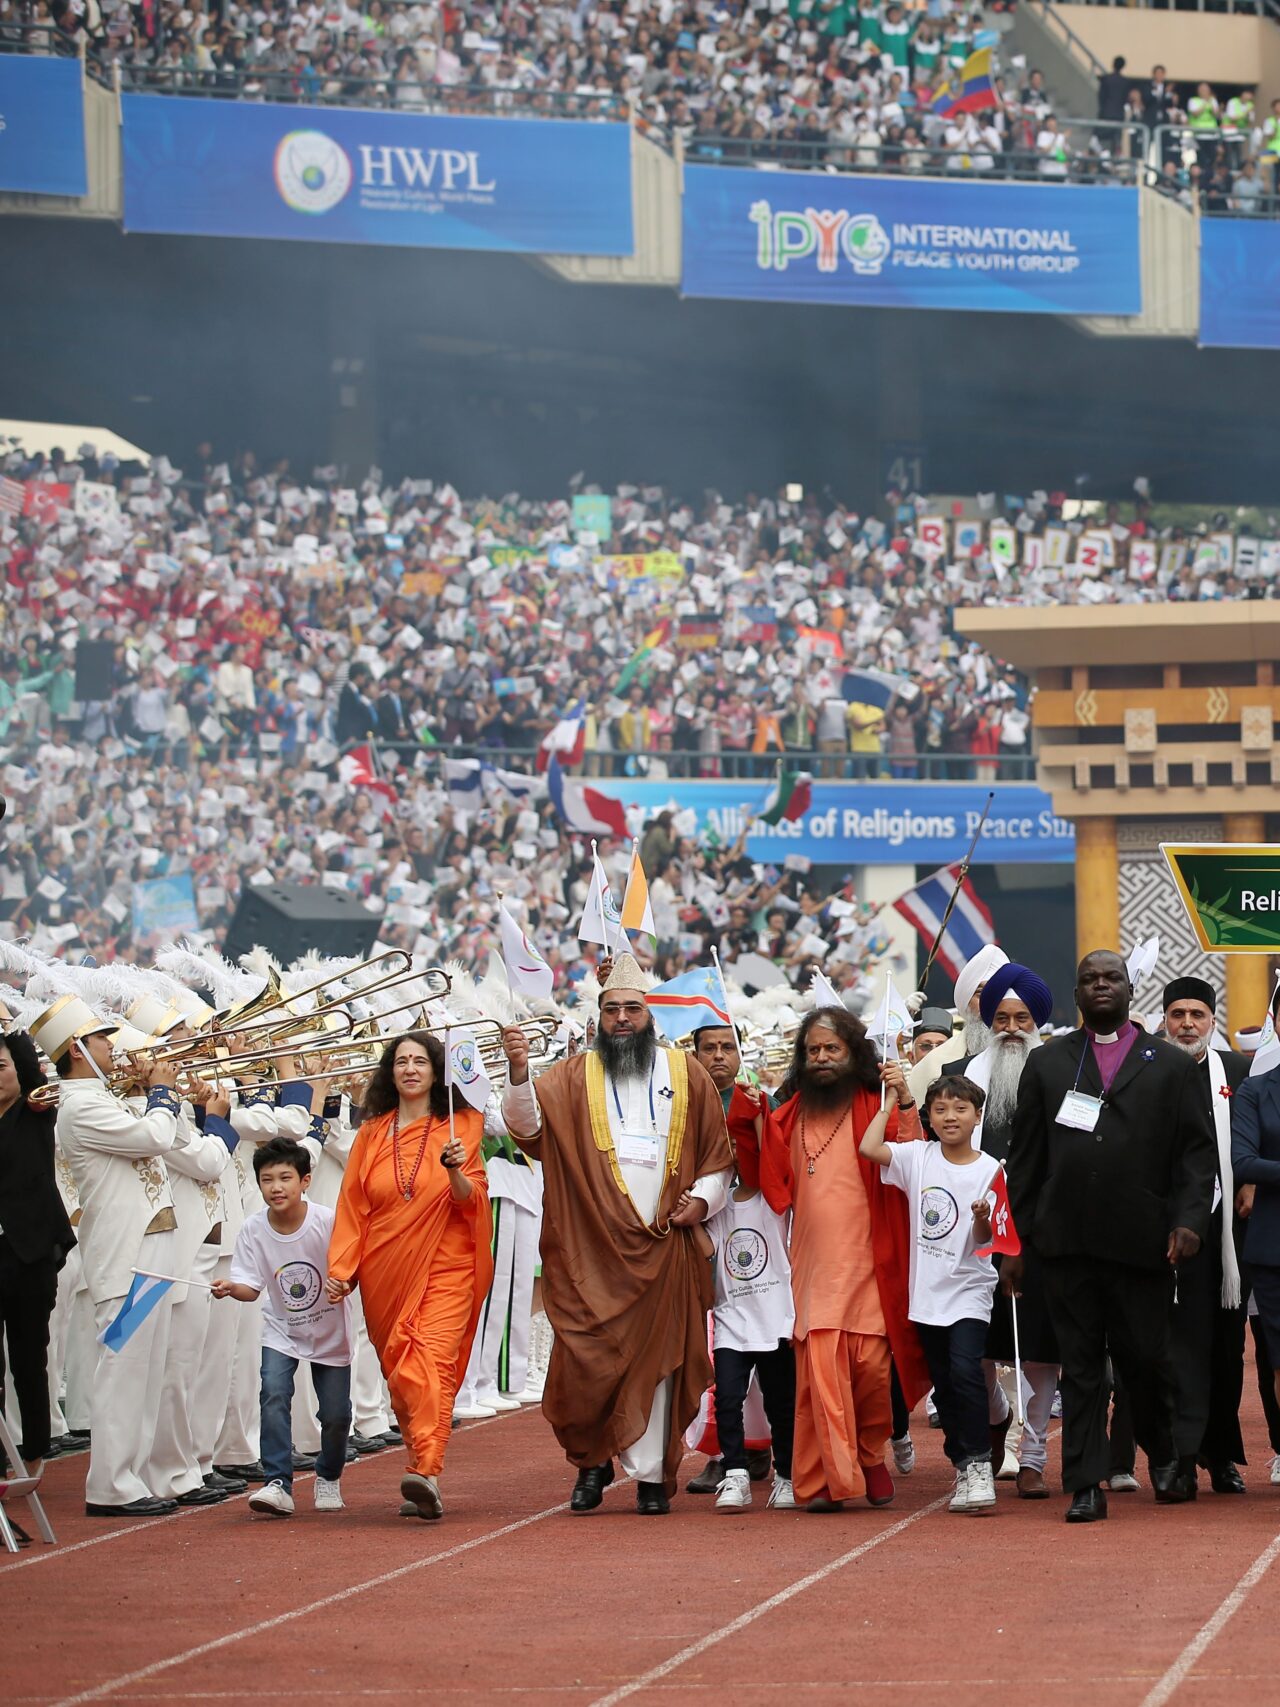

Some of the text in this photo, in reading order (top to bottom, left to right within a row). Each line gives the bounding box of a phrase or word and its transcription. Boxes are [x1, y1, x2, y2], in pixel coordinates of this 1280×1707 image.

[358, 144, 496, 191] HWPL
[892, 223, 1078, 253] INTERNATIONAL
[892, 250, 1079, 274] PEACE YOUTH GROUP
[809, 807, 838, 838] of
[843, 809, 955, 846] Religions
[965, 811, 1033, 839] Peace
